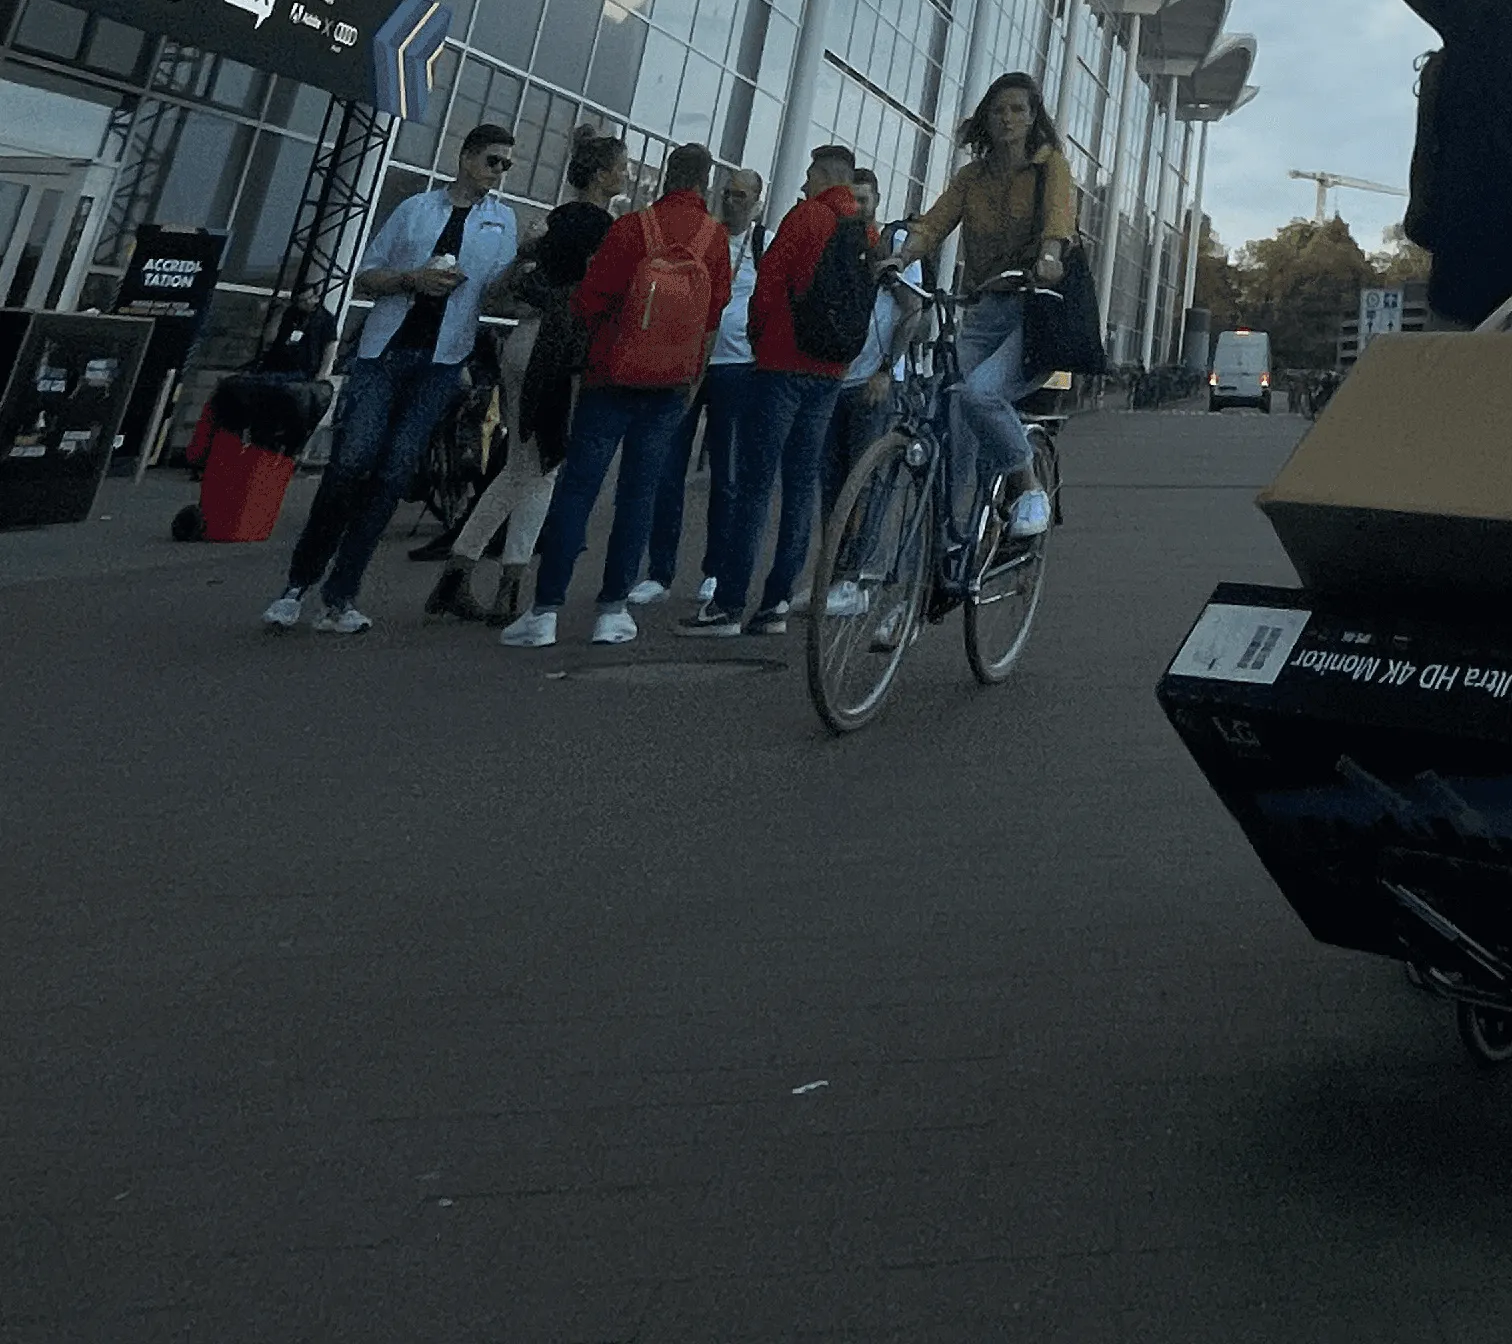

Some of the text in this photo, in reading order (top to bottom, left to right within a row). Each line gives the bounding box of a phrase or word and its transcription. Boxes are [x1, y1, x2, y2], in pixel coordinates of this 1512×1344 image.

[1290, 648, 1382, 683] Monitor
[1377, 658, 1417, 685] 4K
[1418, 663, 1461, 692] HD
